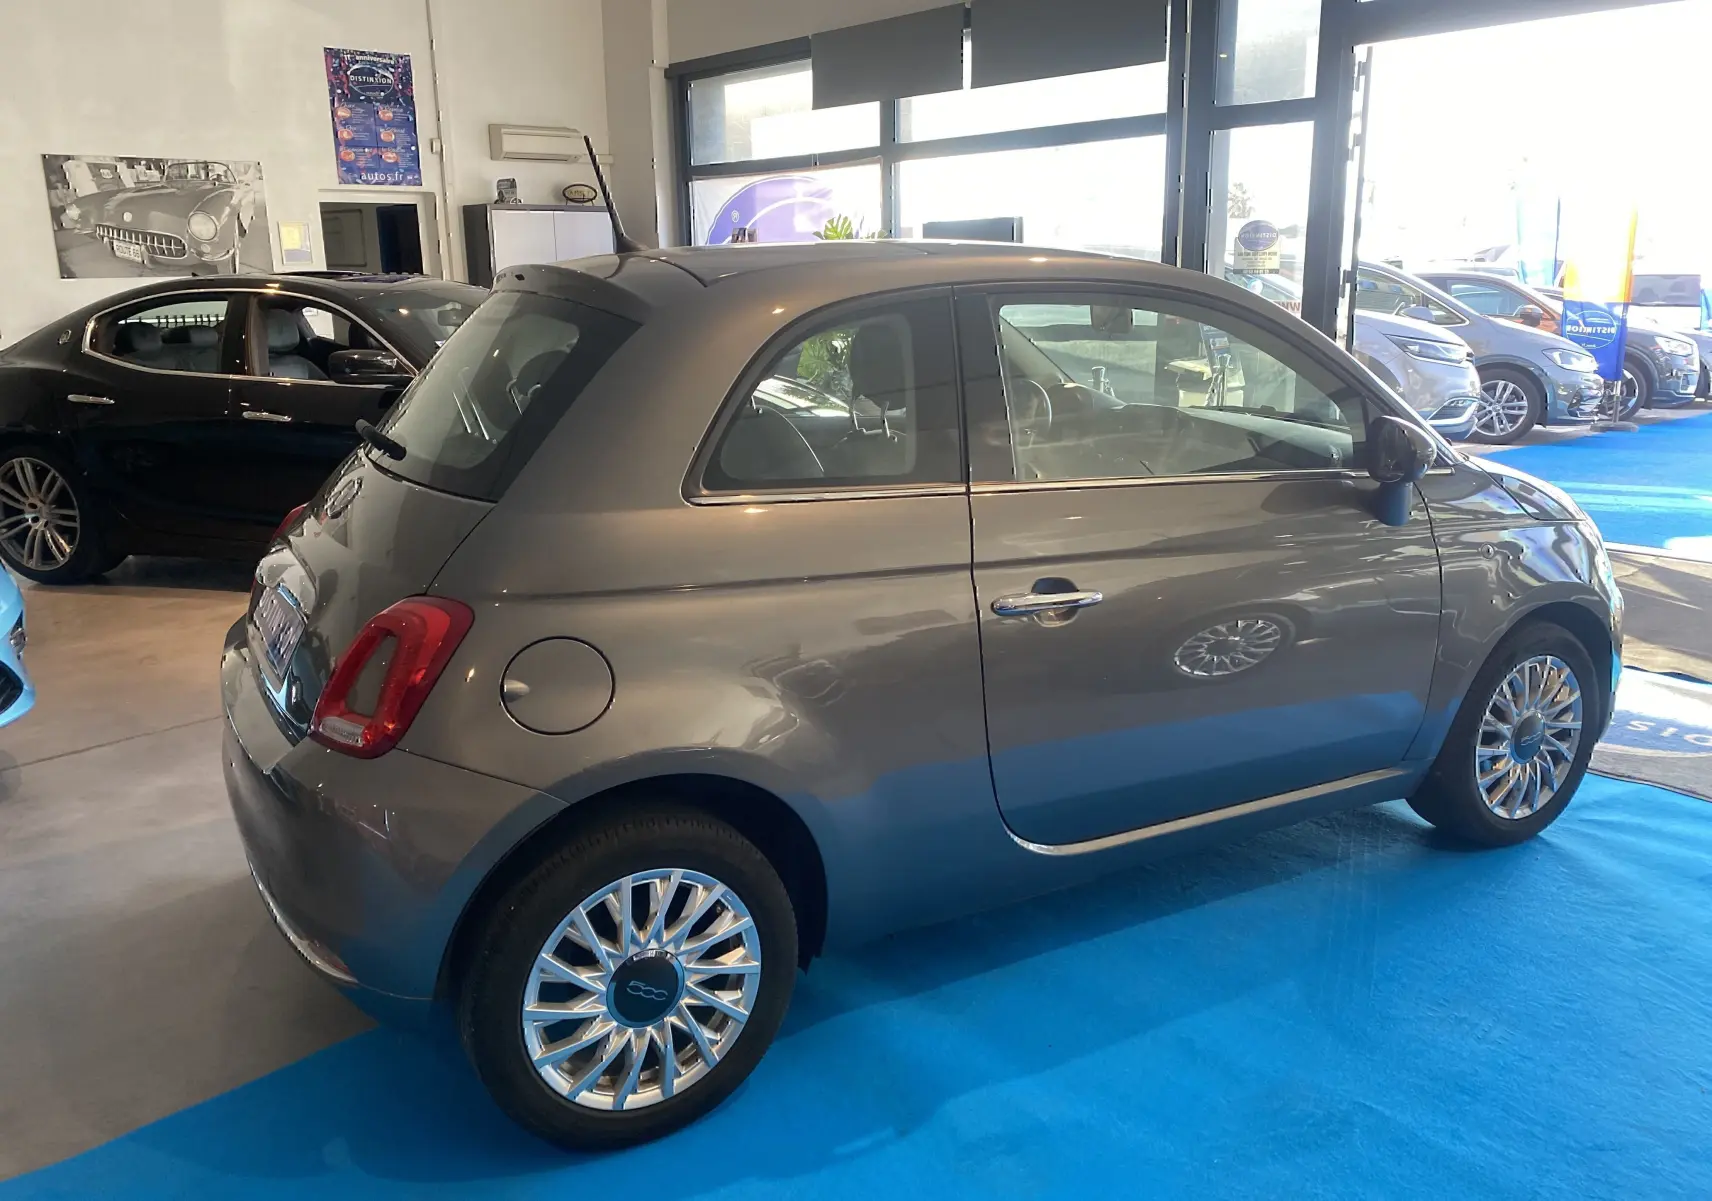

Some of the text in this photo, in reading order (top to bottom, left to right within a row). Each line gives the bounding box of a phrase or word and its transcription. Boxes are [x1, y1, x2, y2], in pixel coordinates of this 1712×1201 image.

[350, 75, 392, 84] DISTINXION
[361, 171, 404, 182] autos.fr
[1611, 720, 1712, 748] SIO
